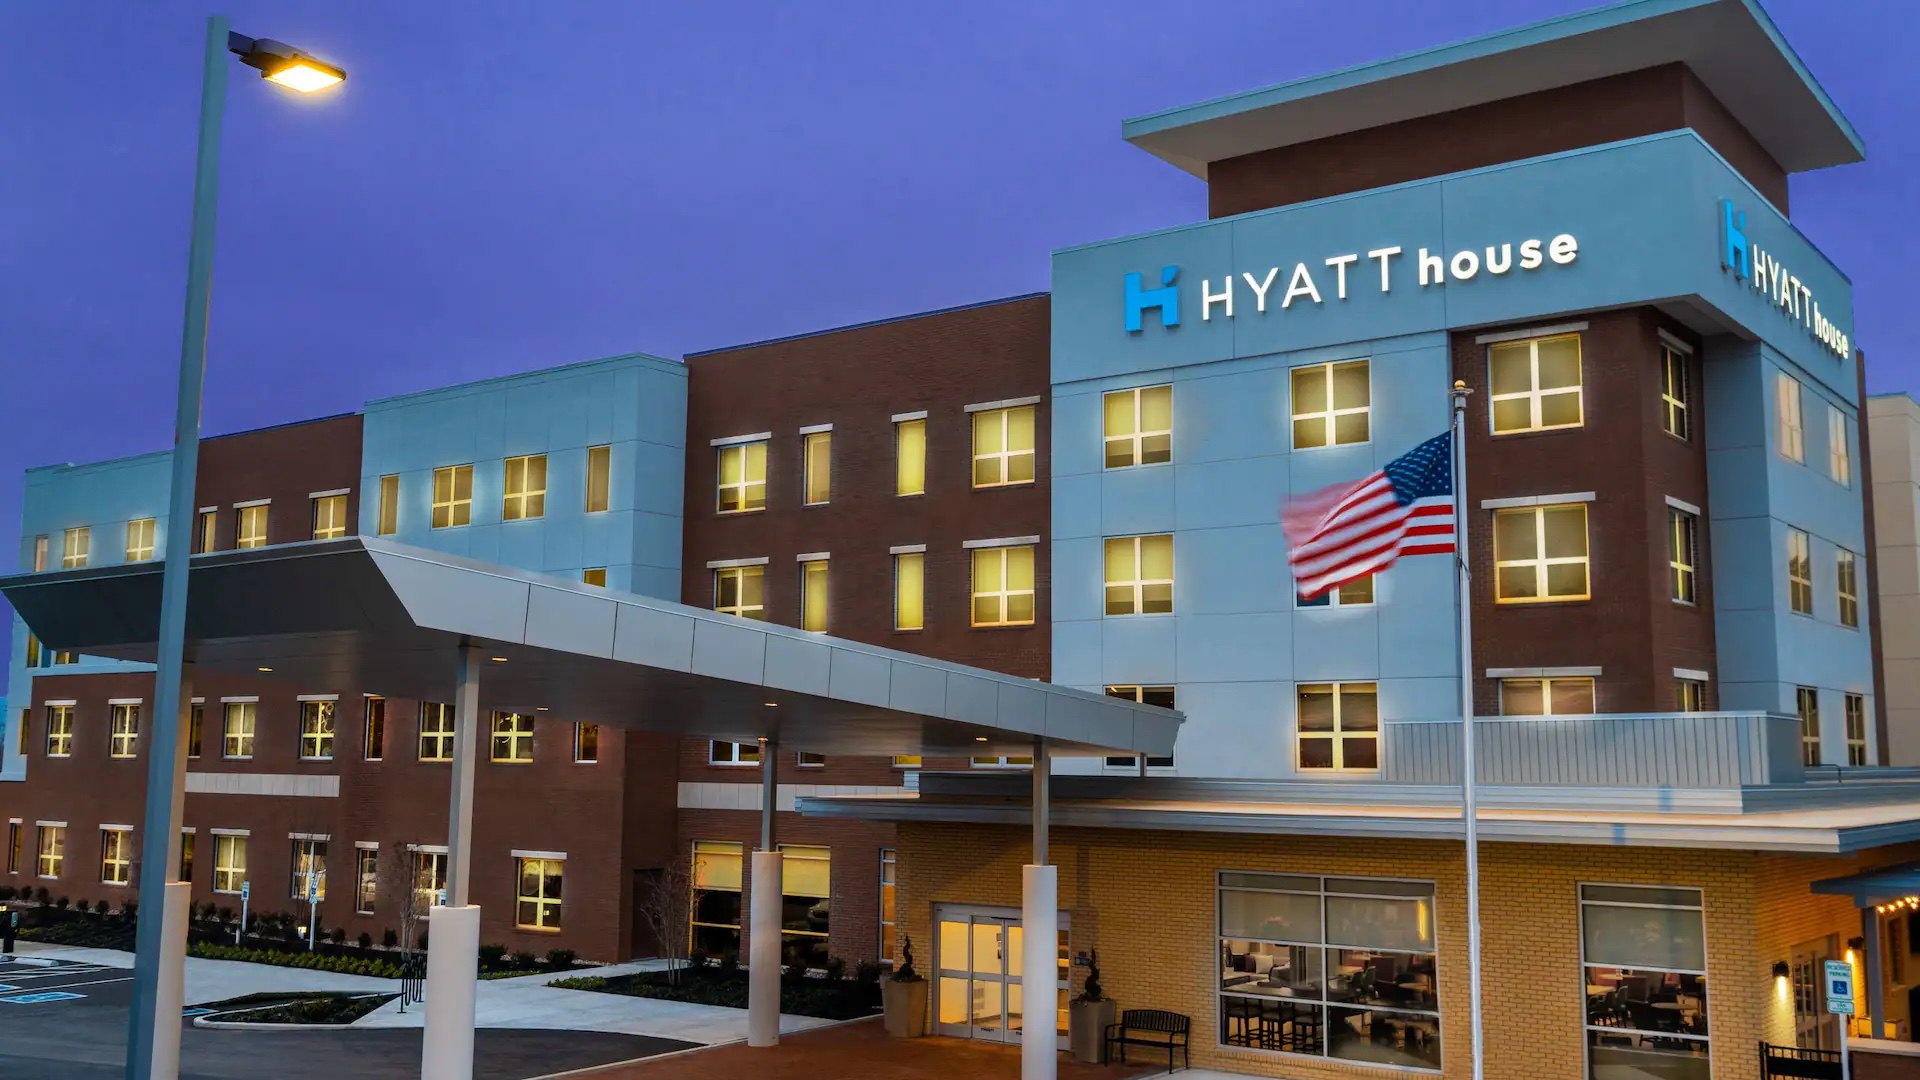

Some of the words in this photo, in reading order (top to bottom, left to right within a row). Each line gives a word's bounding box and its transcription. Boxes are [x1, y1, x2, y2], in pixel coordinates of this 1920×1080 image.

[1202, 246, 1401, 320] HYATT
[1418, 234, 1578, 286] house
[1753, 244, 1811, 328] HYATT
[1814, 301, 1848, 359] house
